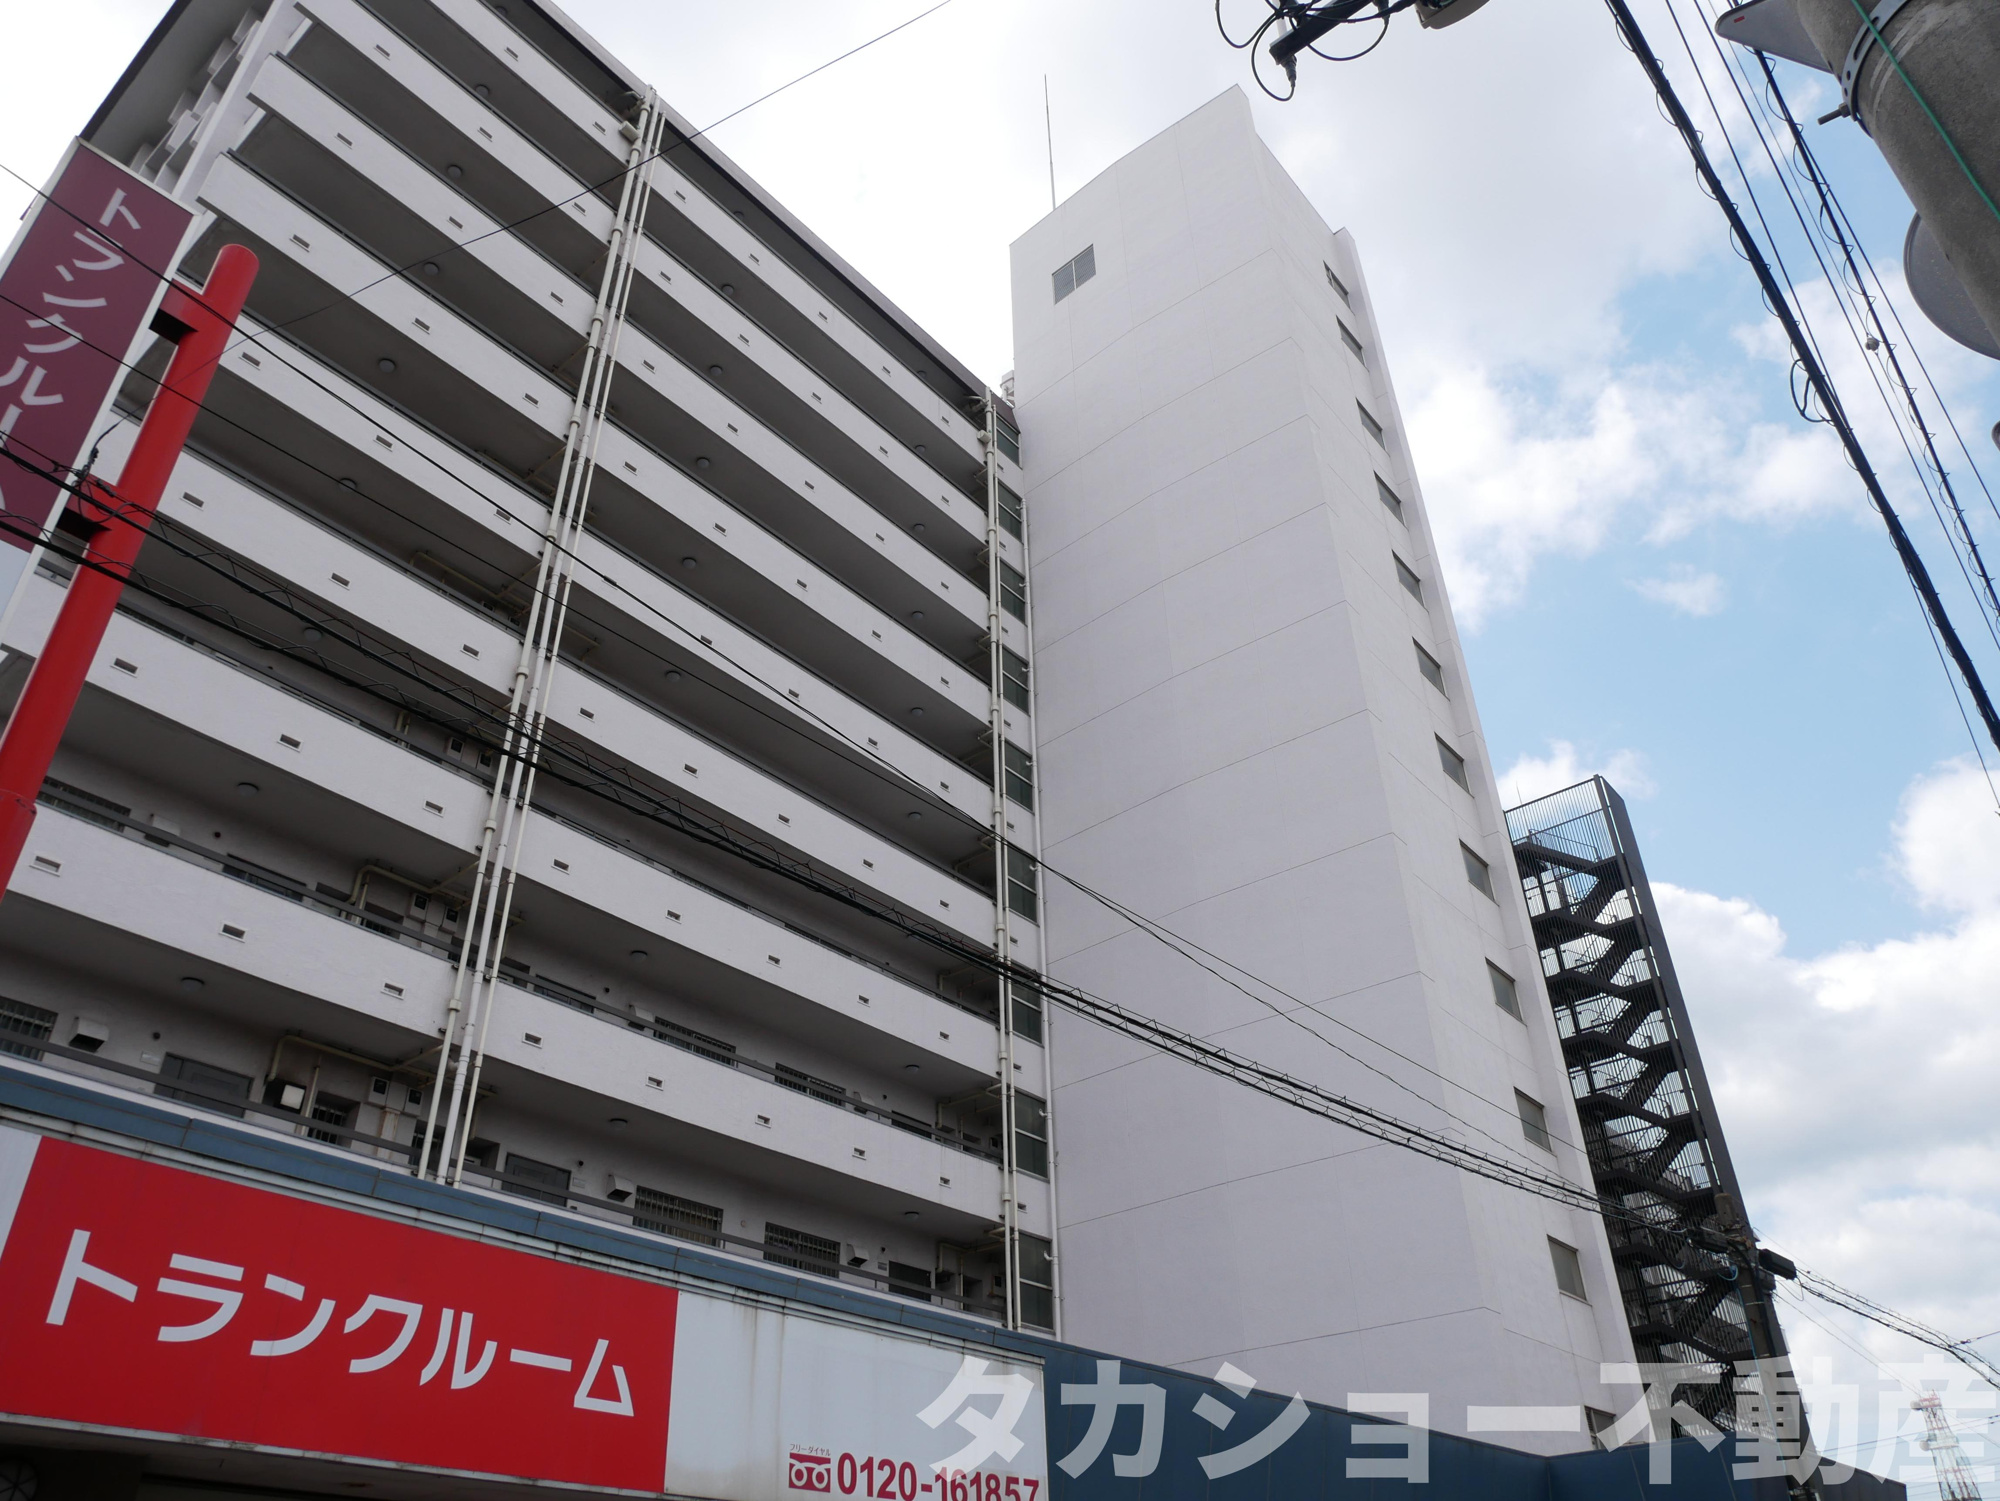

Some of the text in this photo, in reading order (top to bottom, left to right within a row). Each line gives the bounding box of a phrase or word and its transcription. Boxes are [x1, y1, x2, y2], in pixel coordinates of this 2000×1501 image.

[0, 188, 141, 510] トランクルー
[46, 1229, 634, 1416] トランクルーム
[790, 1443, 831, 1457] フリーダイヤル
[837, 1452, 1039, 1501] 0120-161857
